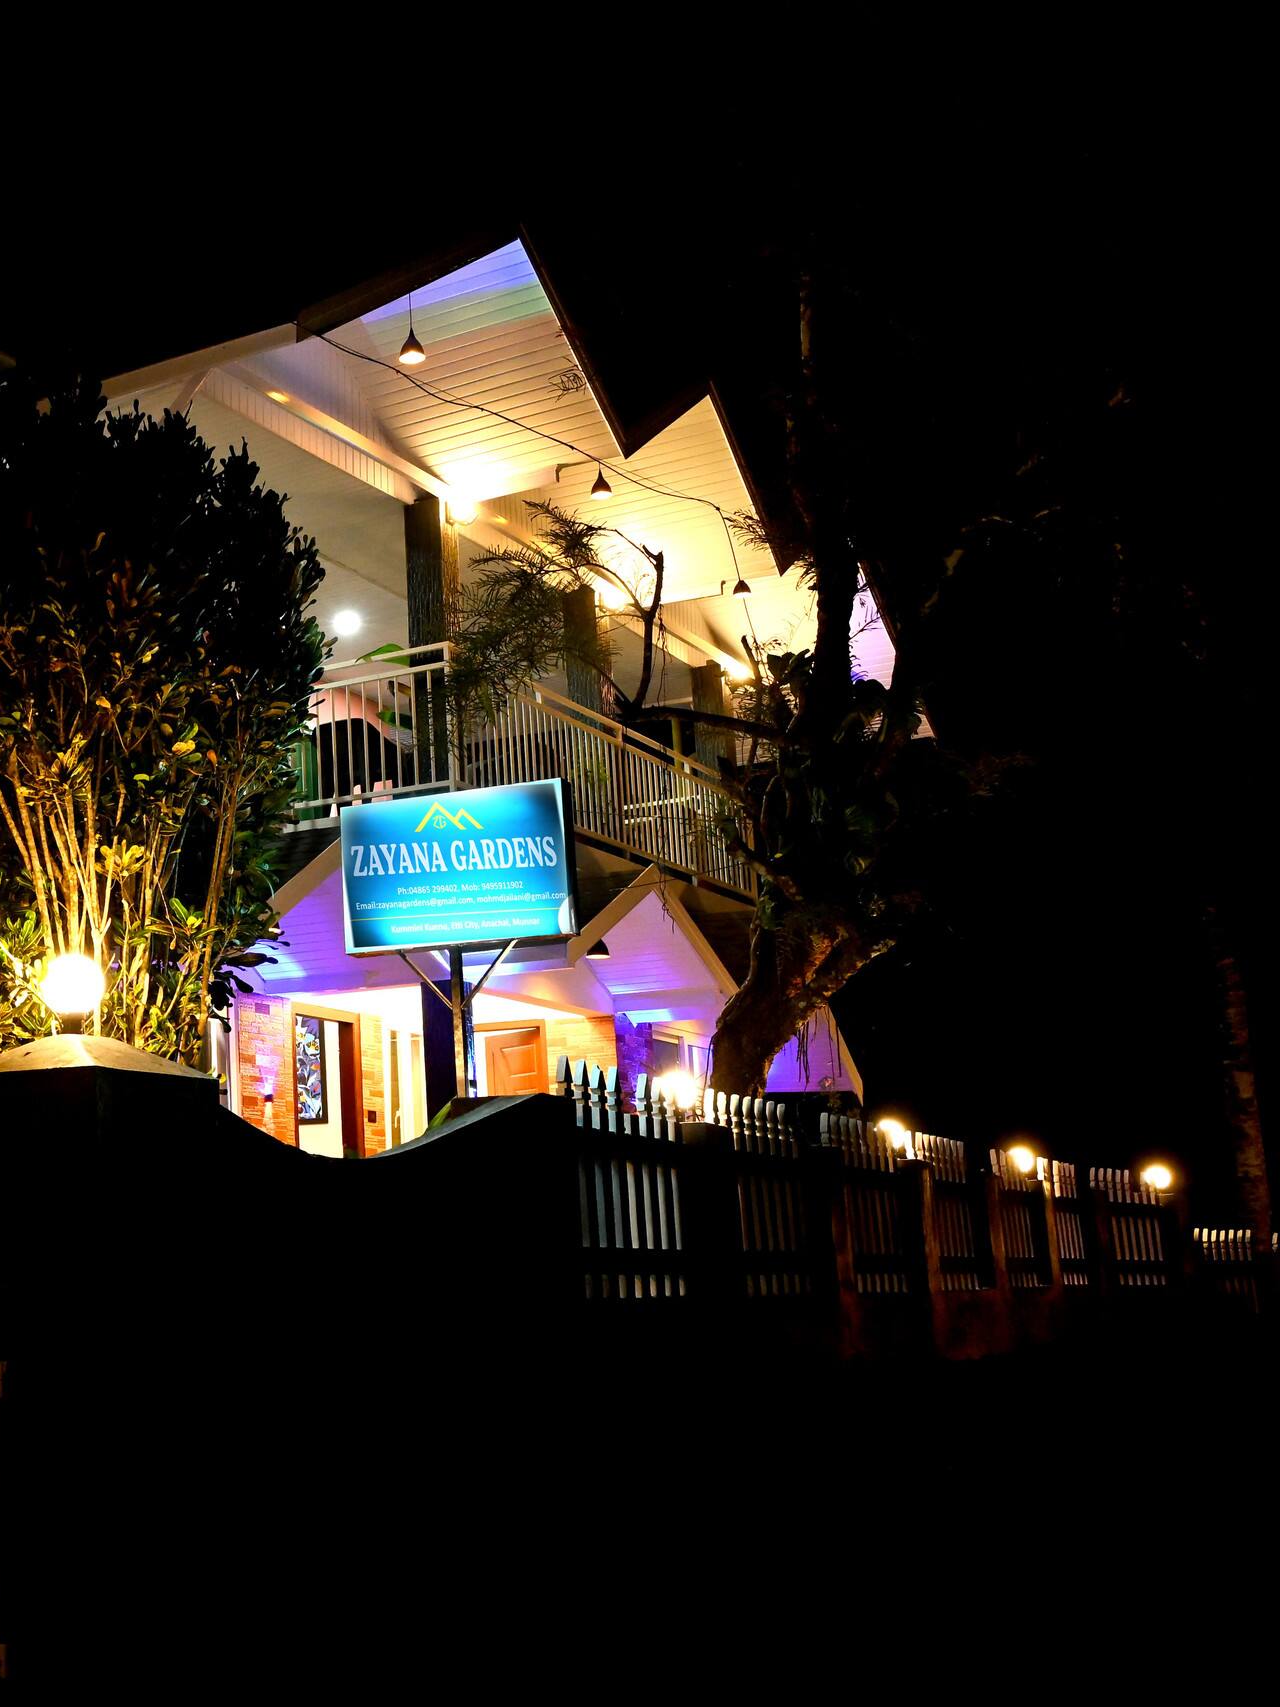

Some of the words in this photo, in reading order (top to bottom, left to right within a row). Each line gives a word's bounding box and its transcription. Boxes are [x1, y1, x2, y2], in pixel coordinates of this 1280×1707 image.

[351, 840, 448, 877] ZAYANA
[451, 836, 557, 872] GARDENS
[397, 885, 431, 896] Ph:04865
[461, 883, 480, 892] Mob:
